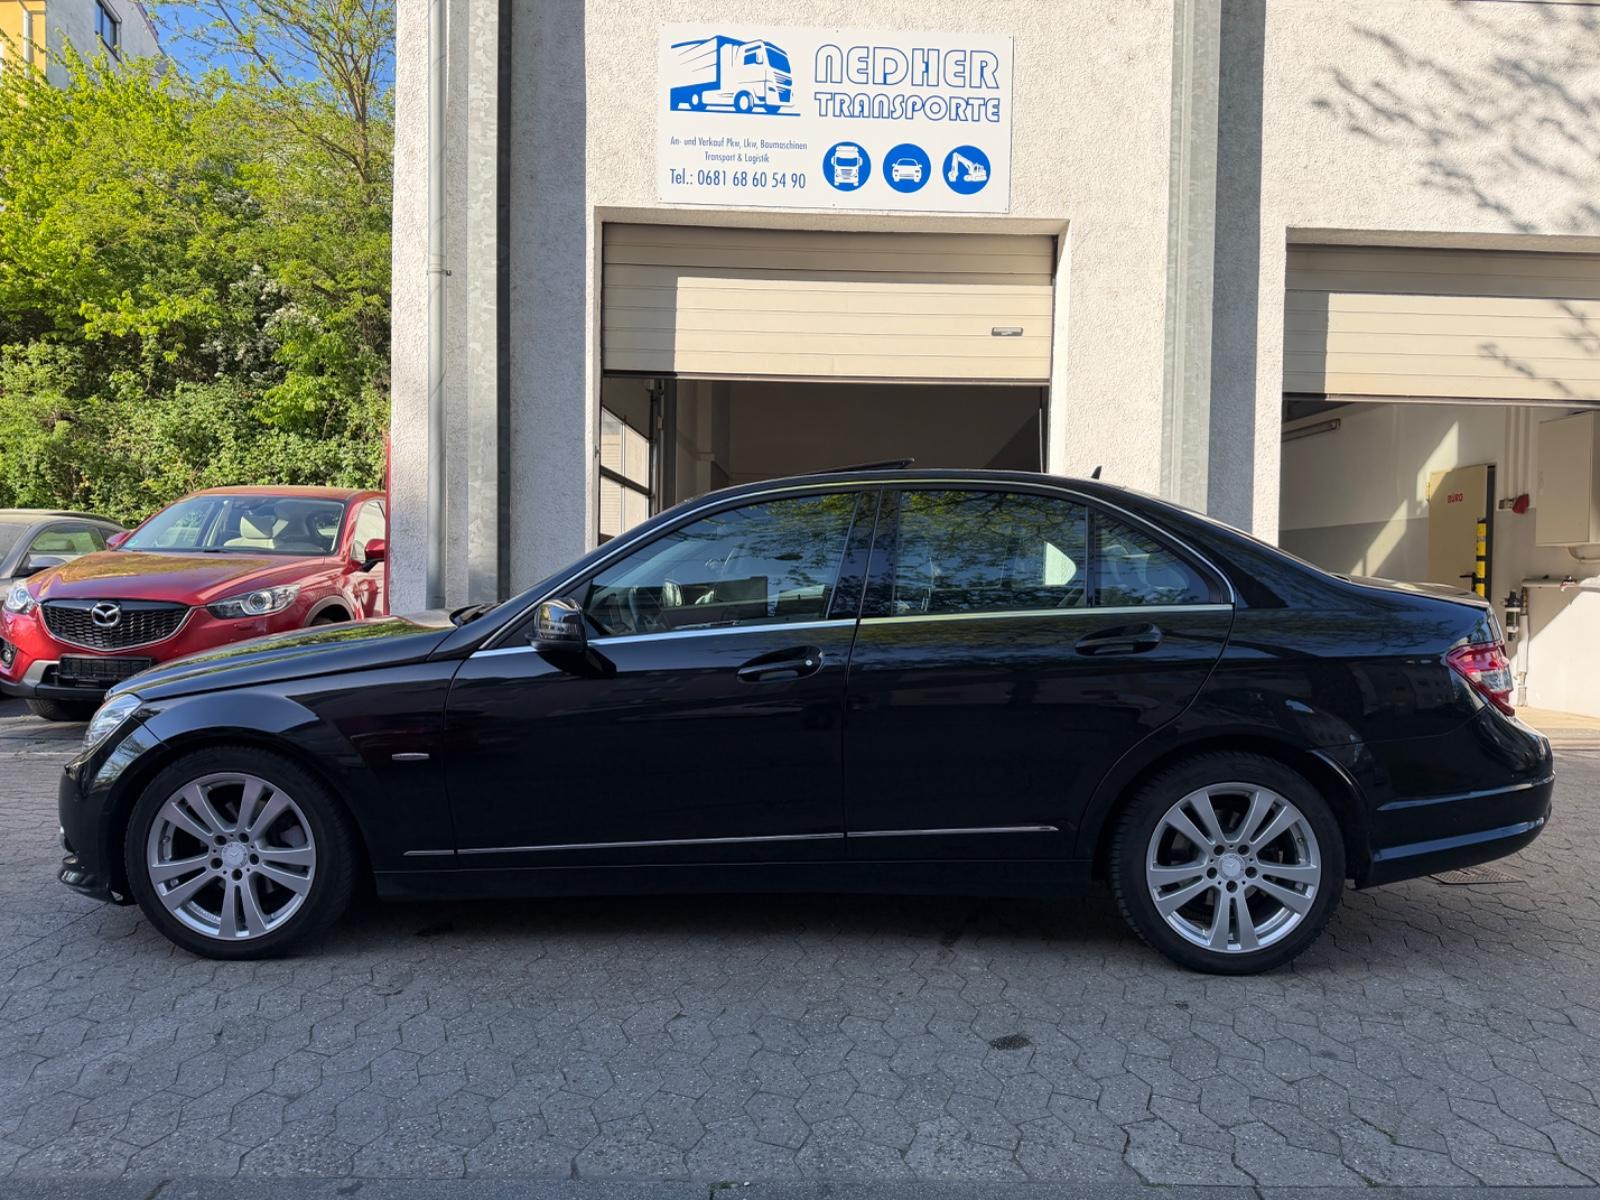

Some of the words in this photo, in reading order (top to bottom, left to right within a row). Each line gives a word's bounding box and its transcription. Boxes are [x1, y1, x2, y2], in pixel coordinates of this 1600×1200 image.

[815, 44, 1000, 89] NEDHER
[814, 92, 1000, 122] TRANSPORTE
[670, 136, 682, 145] An-
[684, 137, 697, 146] und
[698, 137, 725, 147] Verkauf
[726, 138, 742, 149] Pkw,
[743, 138, 758, 149] Lkw,
[760, 140, 808, 150] Baumaschinen
[705, 151, 735, 163] Transport
[737, 153, 743, 162] &
[745, 153, 770, 165] Logistik
[669, 168, 694, 185] Tel.:
[697, 169, 726, 186] 0681
[732, 171, 748, 187] 68
[752, 171, 767, 188] 60
[771, 172, 786, 188] 54
[791, 172, 806, 189] 90
